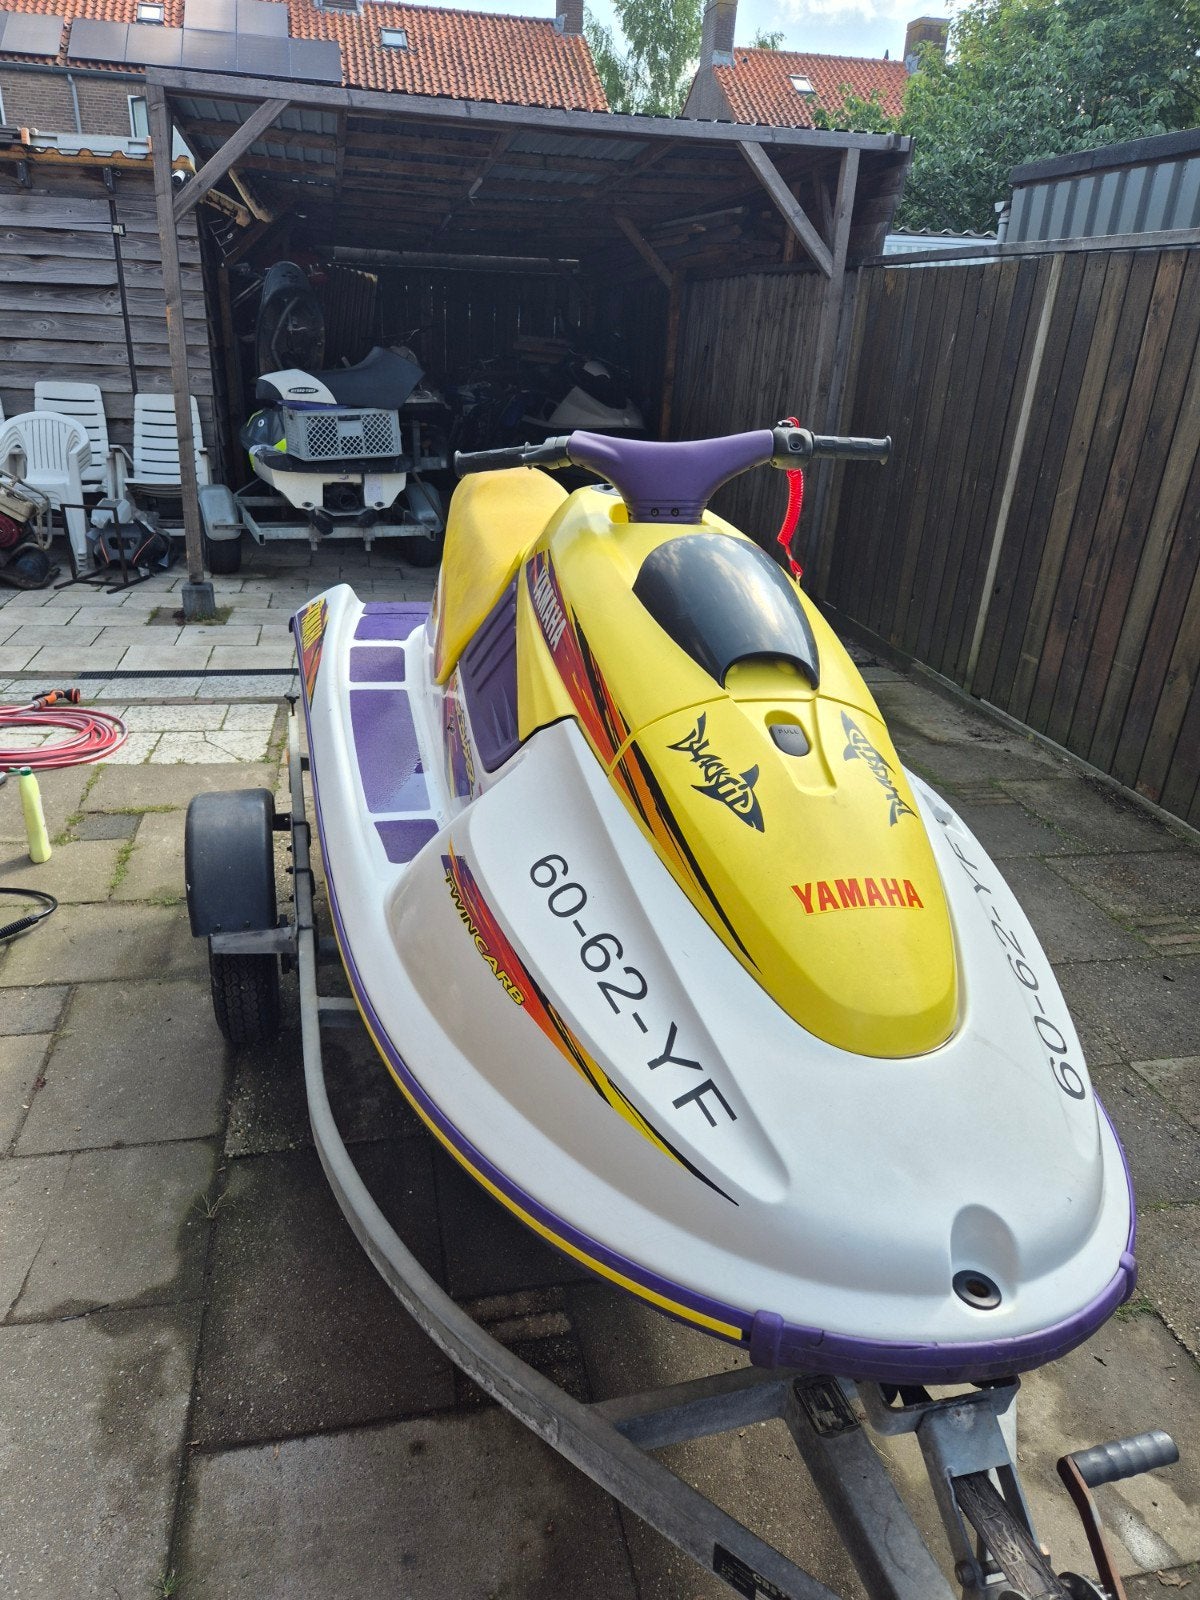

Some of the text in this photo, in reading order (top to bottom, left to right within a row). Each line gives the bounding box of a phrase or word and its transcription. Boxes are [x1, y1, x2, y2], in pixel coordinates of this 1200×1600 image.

[533, 565, 566, 652] YAMAHA
[790, 877, 924, 914] YAMAHA
[945, 833, 1086, 1100] 60-62-YF
[530, 854, 738, 1128] 60-62-YF
